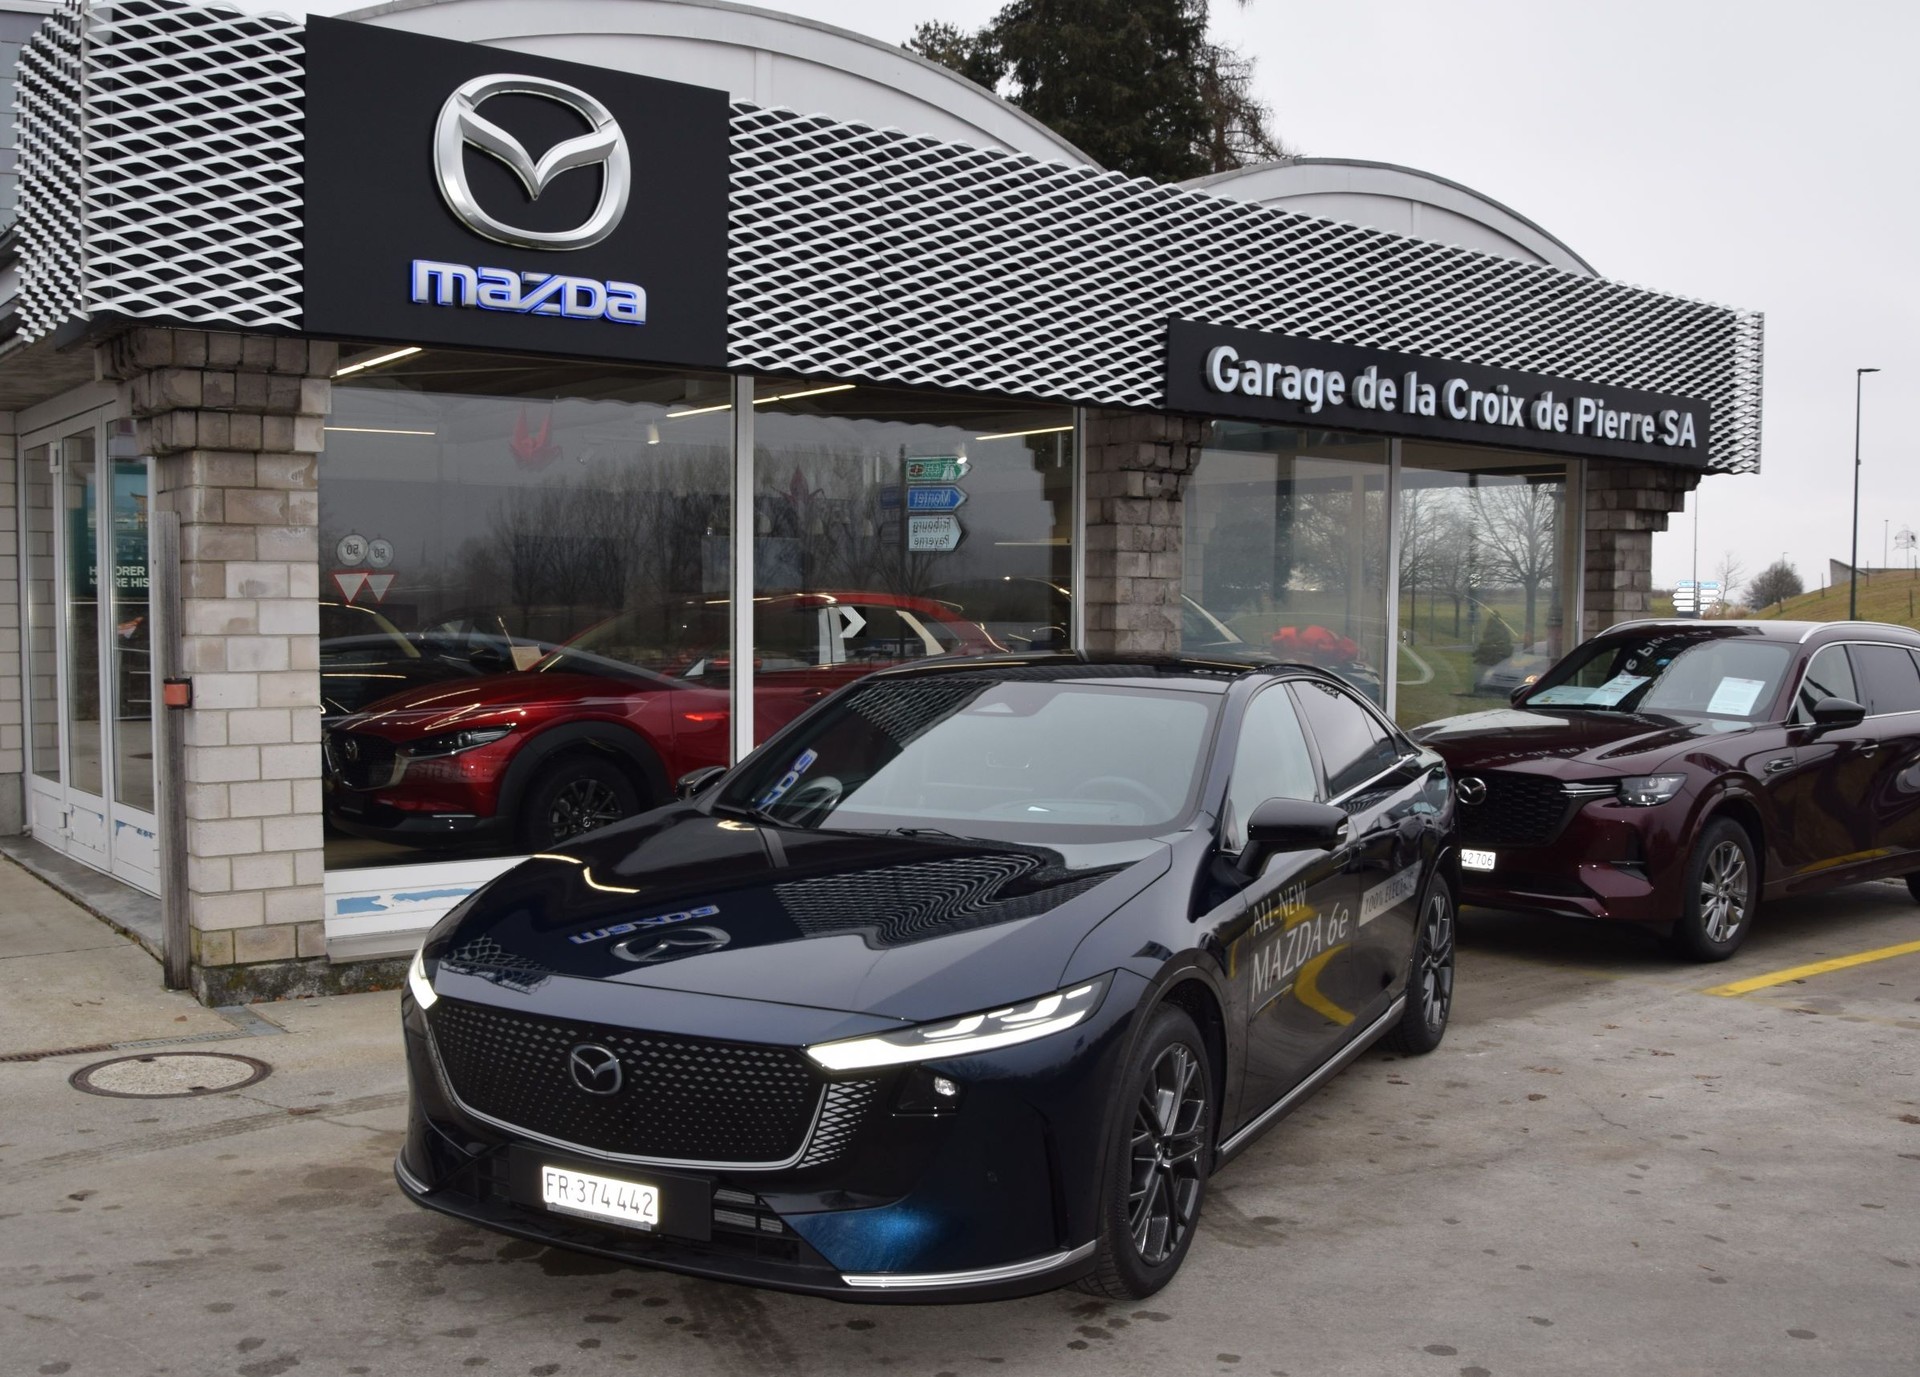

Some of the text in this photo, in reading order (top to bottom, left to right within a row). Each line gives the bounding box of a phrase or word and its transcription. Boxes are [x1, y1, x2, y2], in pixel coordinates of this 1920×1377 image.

[1206, 345, 1697, 448] Garage de la Croix de Pierre SA
[1251, 902, 1349, 1002] MAZDA 6e
[1253, 880, 1307, 936] ALL-NEW
